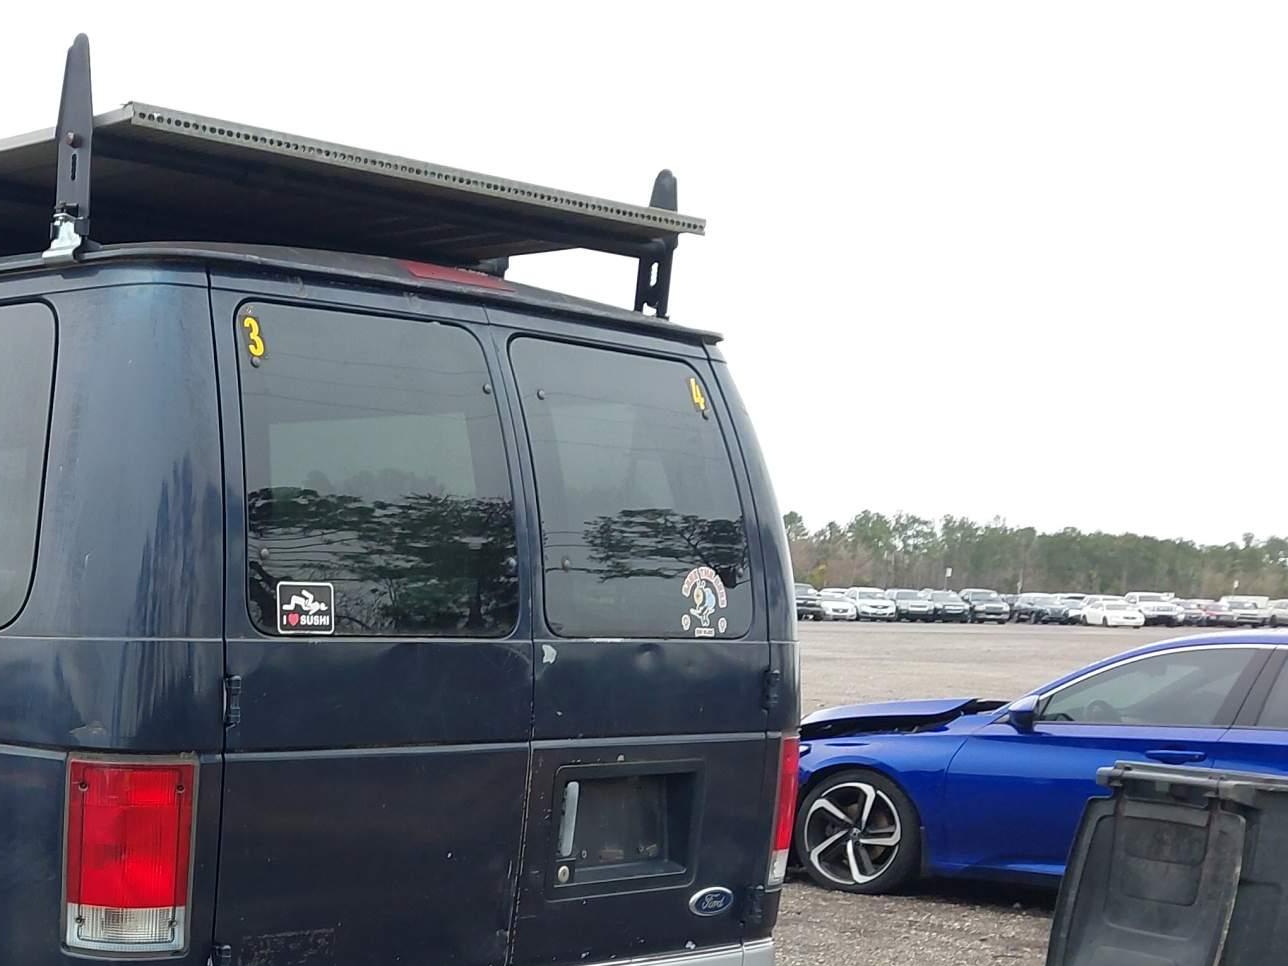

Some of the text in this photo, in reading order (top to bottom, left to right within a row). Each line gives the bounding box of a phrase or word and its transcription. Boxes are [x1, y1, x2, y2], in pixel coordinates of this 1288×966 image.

[243, 316, 264, 356] 3
[690, 377, 706, 410] 4
[282, 614, 330, 626] I SUSHI
